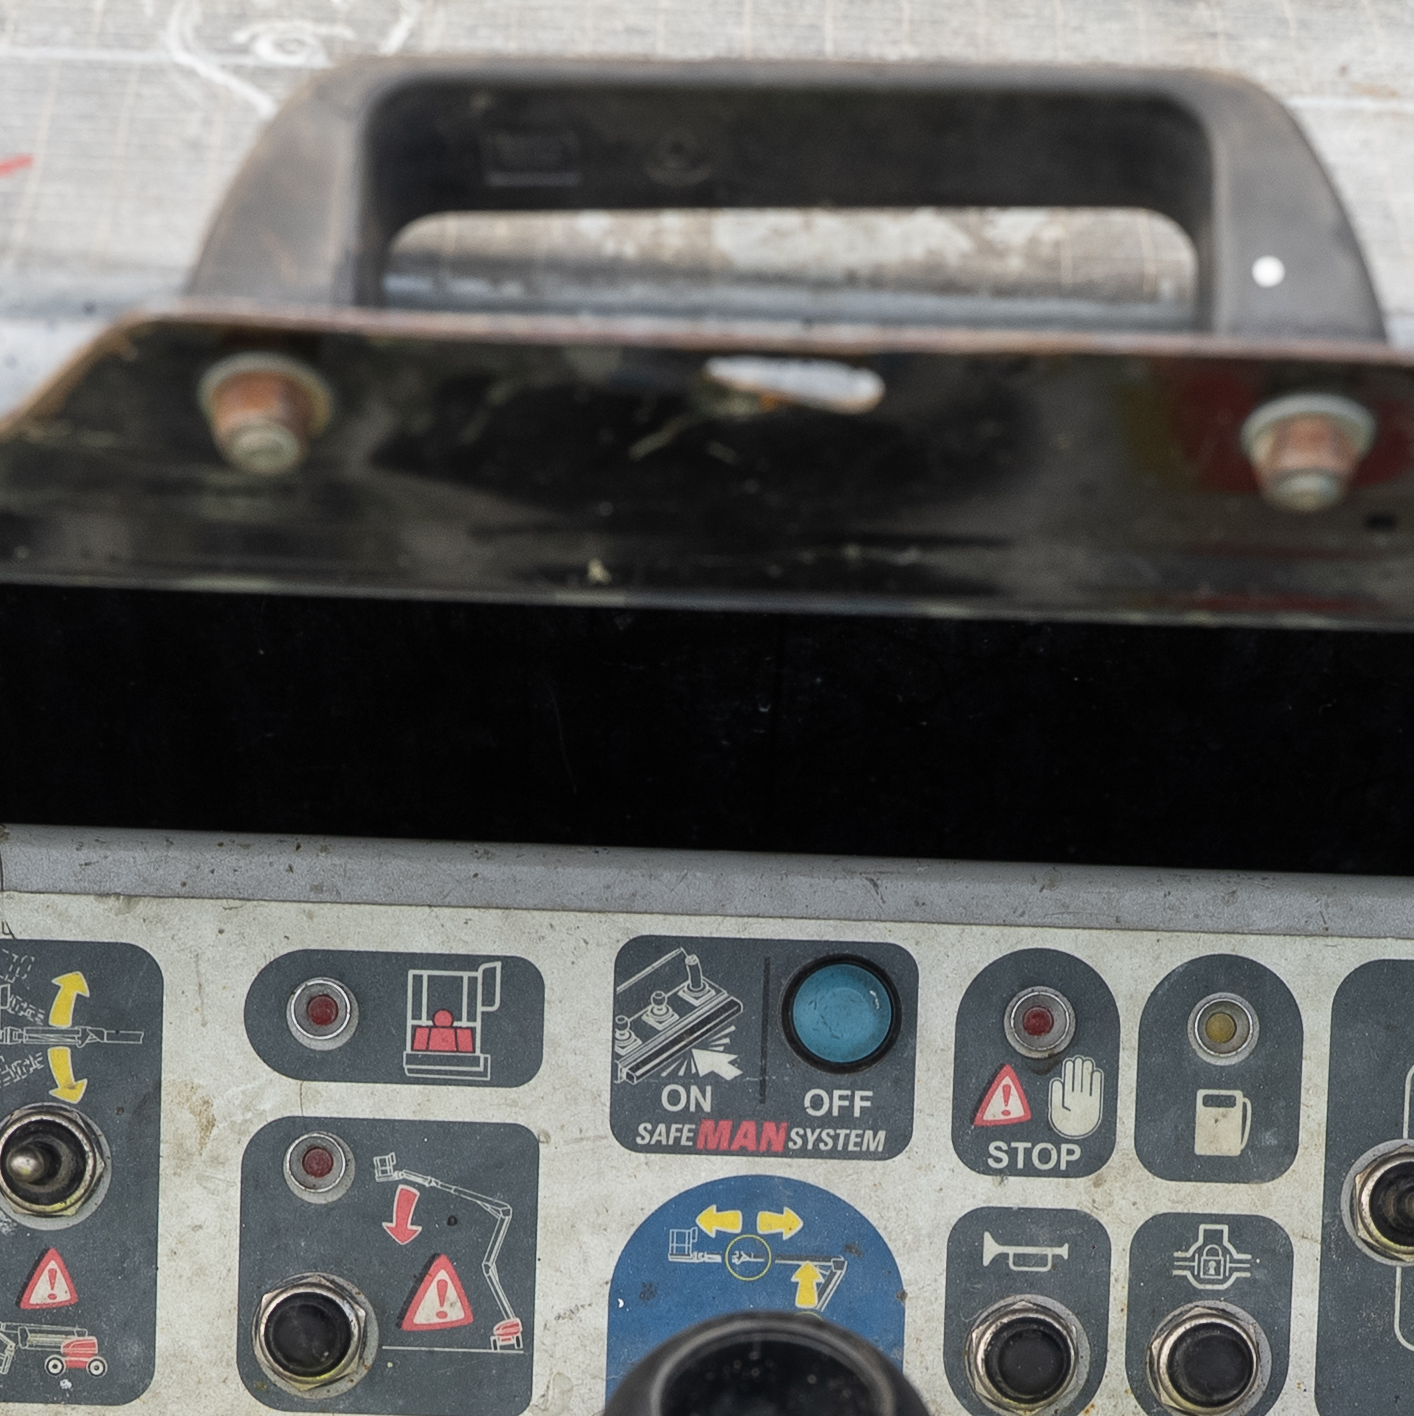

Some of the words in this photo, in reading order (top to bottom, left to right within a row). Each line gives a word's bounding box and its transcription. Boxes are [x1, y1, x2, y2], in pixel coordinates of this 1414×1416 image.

[661, 1084, 712, 1113] ON
[803, 1088, 873, 1118] OFF
[696, 1119, 788, 1152] MAN
[788, 1127, 887, 1152] SYSTEM
[987, 1140, 1082, 1171] STOP
